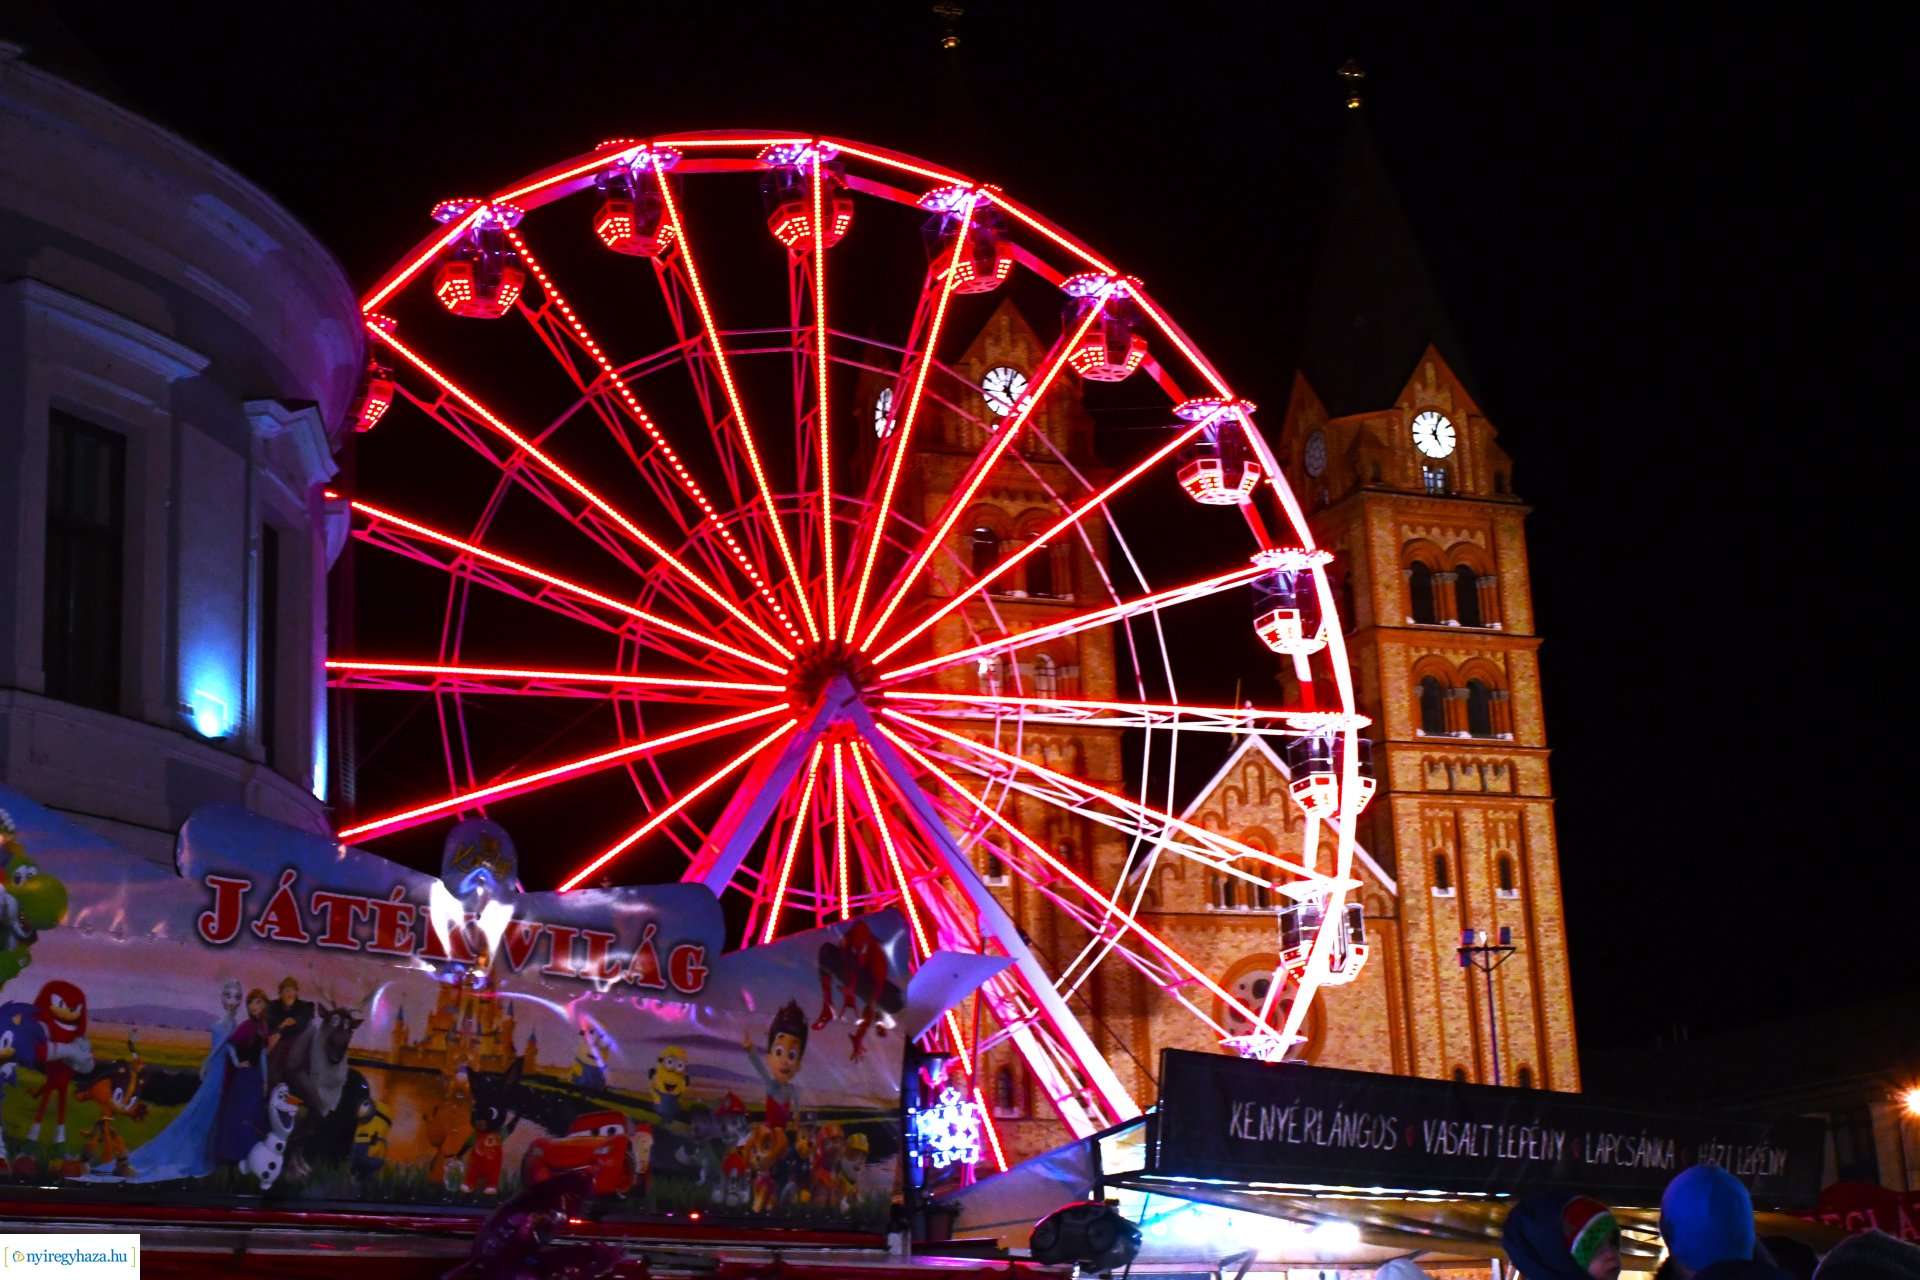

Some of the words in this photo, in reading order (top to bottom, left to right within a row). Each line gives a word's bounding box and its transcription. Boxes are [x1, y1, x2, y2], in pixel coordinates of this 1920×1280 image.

[1229, 1097, 1398, 1151] KENYÉRLÁNGOS
[1423, 1118, 1494, 1157] VASALT
[1497, 1117, 1566, 1161] LEPÉNY
[1585, 1128, 1676, 1170] LAPCSÁNKA
